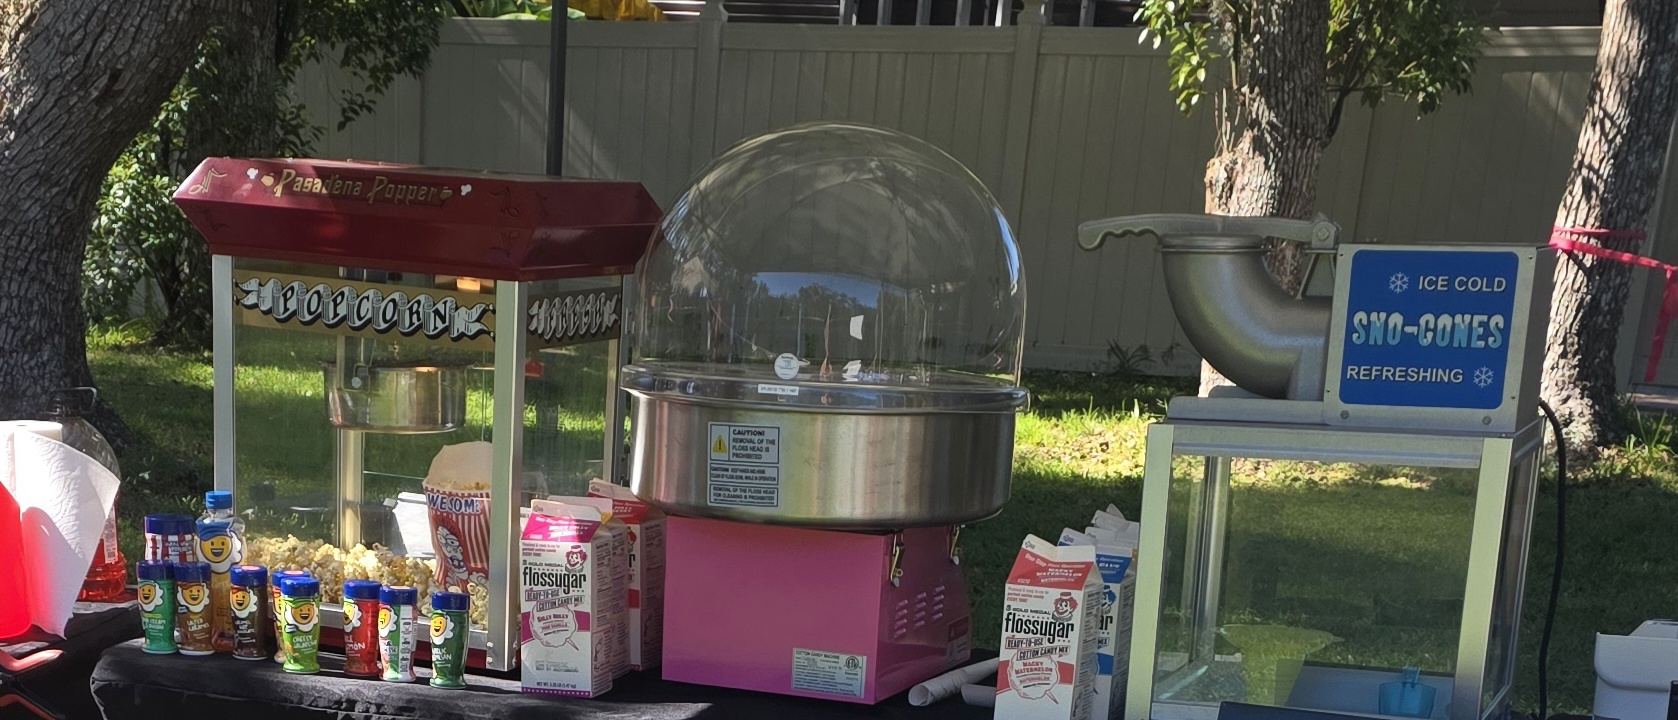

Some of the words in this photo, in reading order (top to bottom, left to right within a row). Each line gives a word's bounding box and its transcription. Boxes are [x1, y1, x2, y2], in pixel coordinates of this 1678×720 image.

[273, 168, 363, 198] Pasadena
[367, 175, 438, 205] Popper
[1418, 276, 1449, 291] ICE
[1454, 276, 1507, 292] COLD
[281, 285, 447, 332] POPCORN
[1351, 310, 1505, 349] SNO-CONES
[1346, 365, 1463, 383] REFRESHING
[522, 566, 587, 595] flossugar
[1005, 612, 1074, 644] flossugar
[1020, 649, 1040, 658] COTTON
[1040, 647, 1057, 656] CANDY
